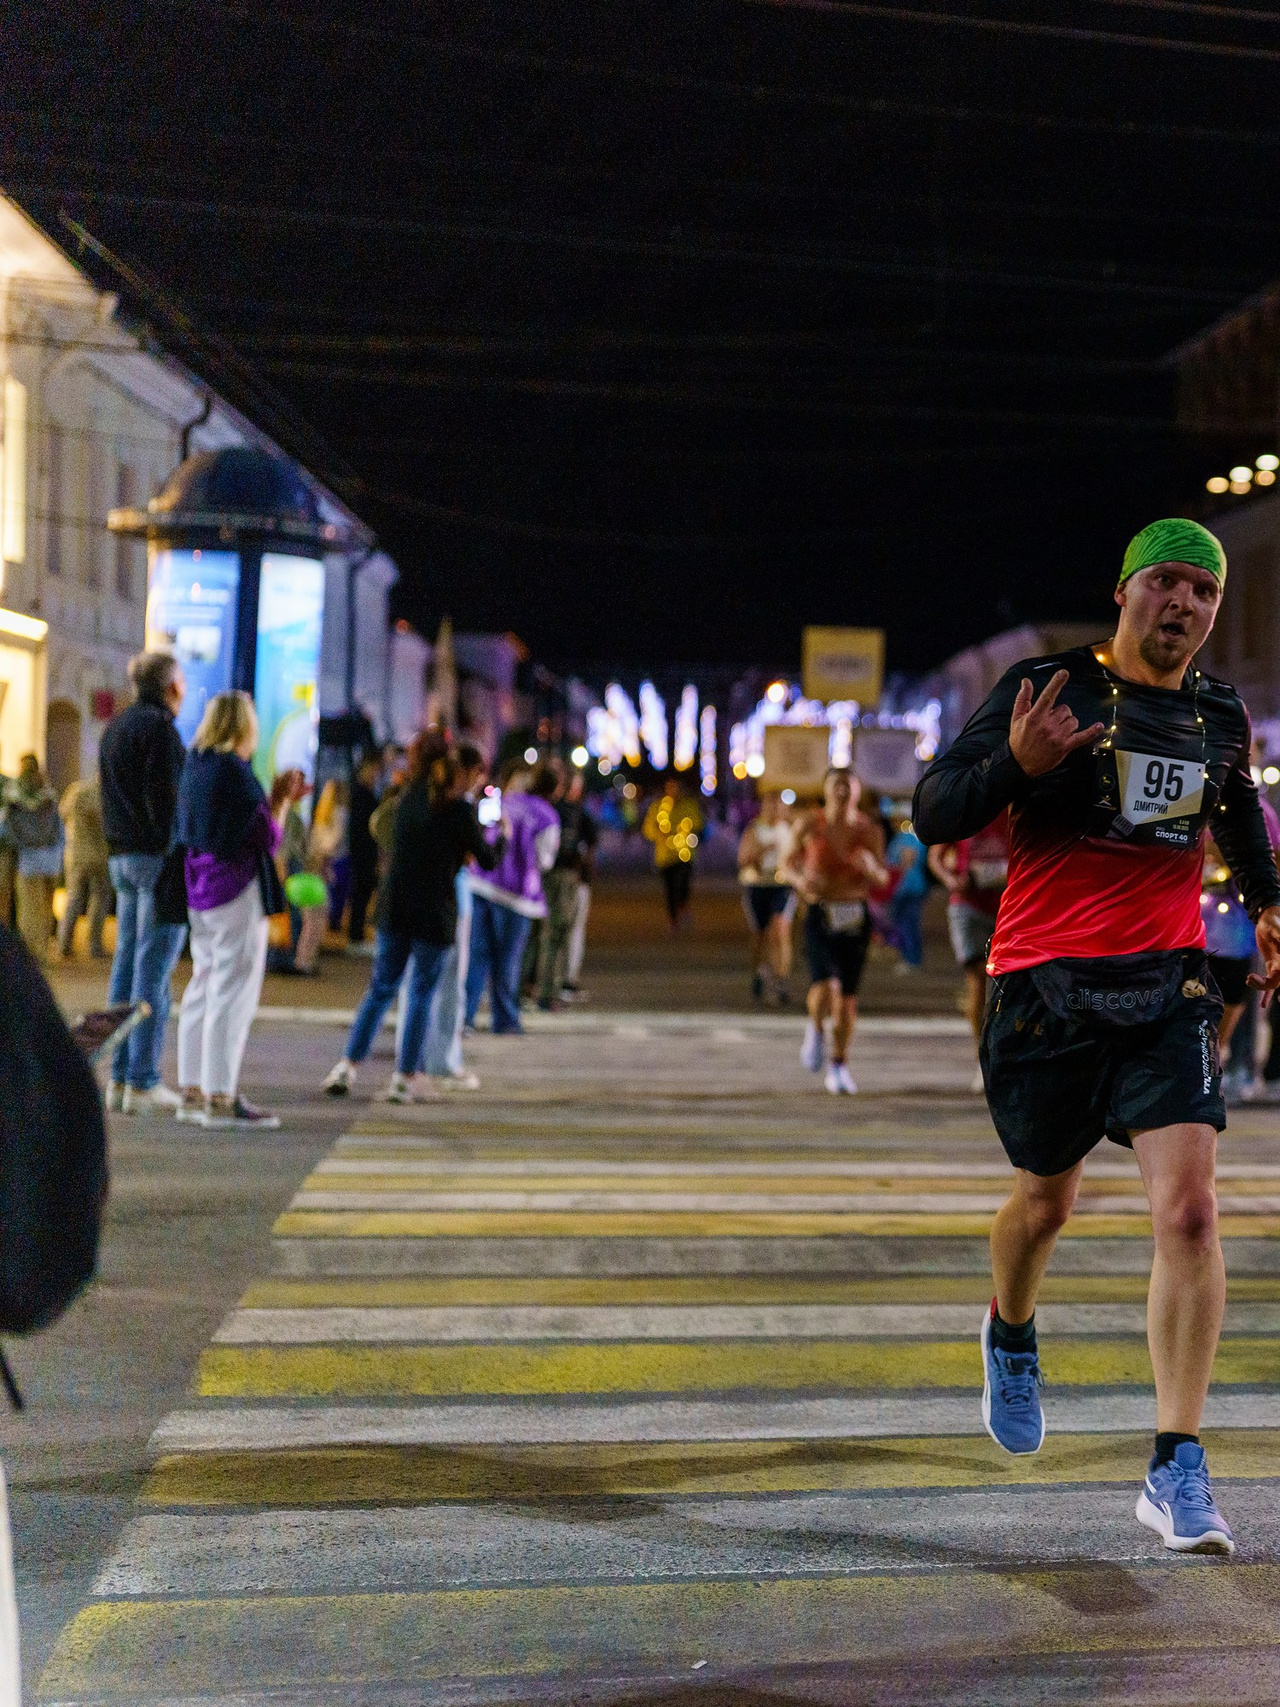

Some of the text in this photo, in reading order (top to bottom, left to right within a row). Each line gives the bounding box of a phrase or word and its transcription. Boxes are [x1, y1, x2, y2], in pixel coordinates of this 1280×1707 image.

[1143, 760, 1185, 802] 95
[1133, 800, 1169, 815] ДМИТРИЙ
[1155, 831, 1179, 840] СПОРТ
